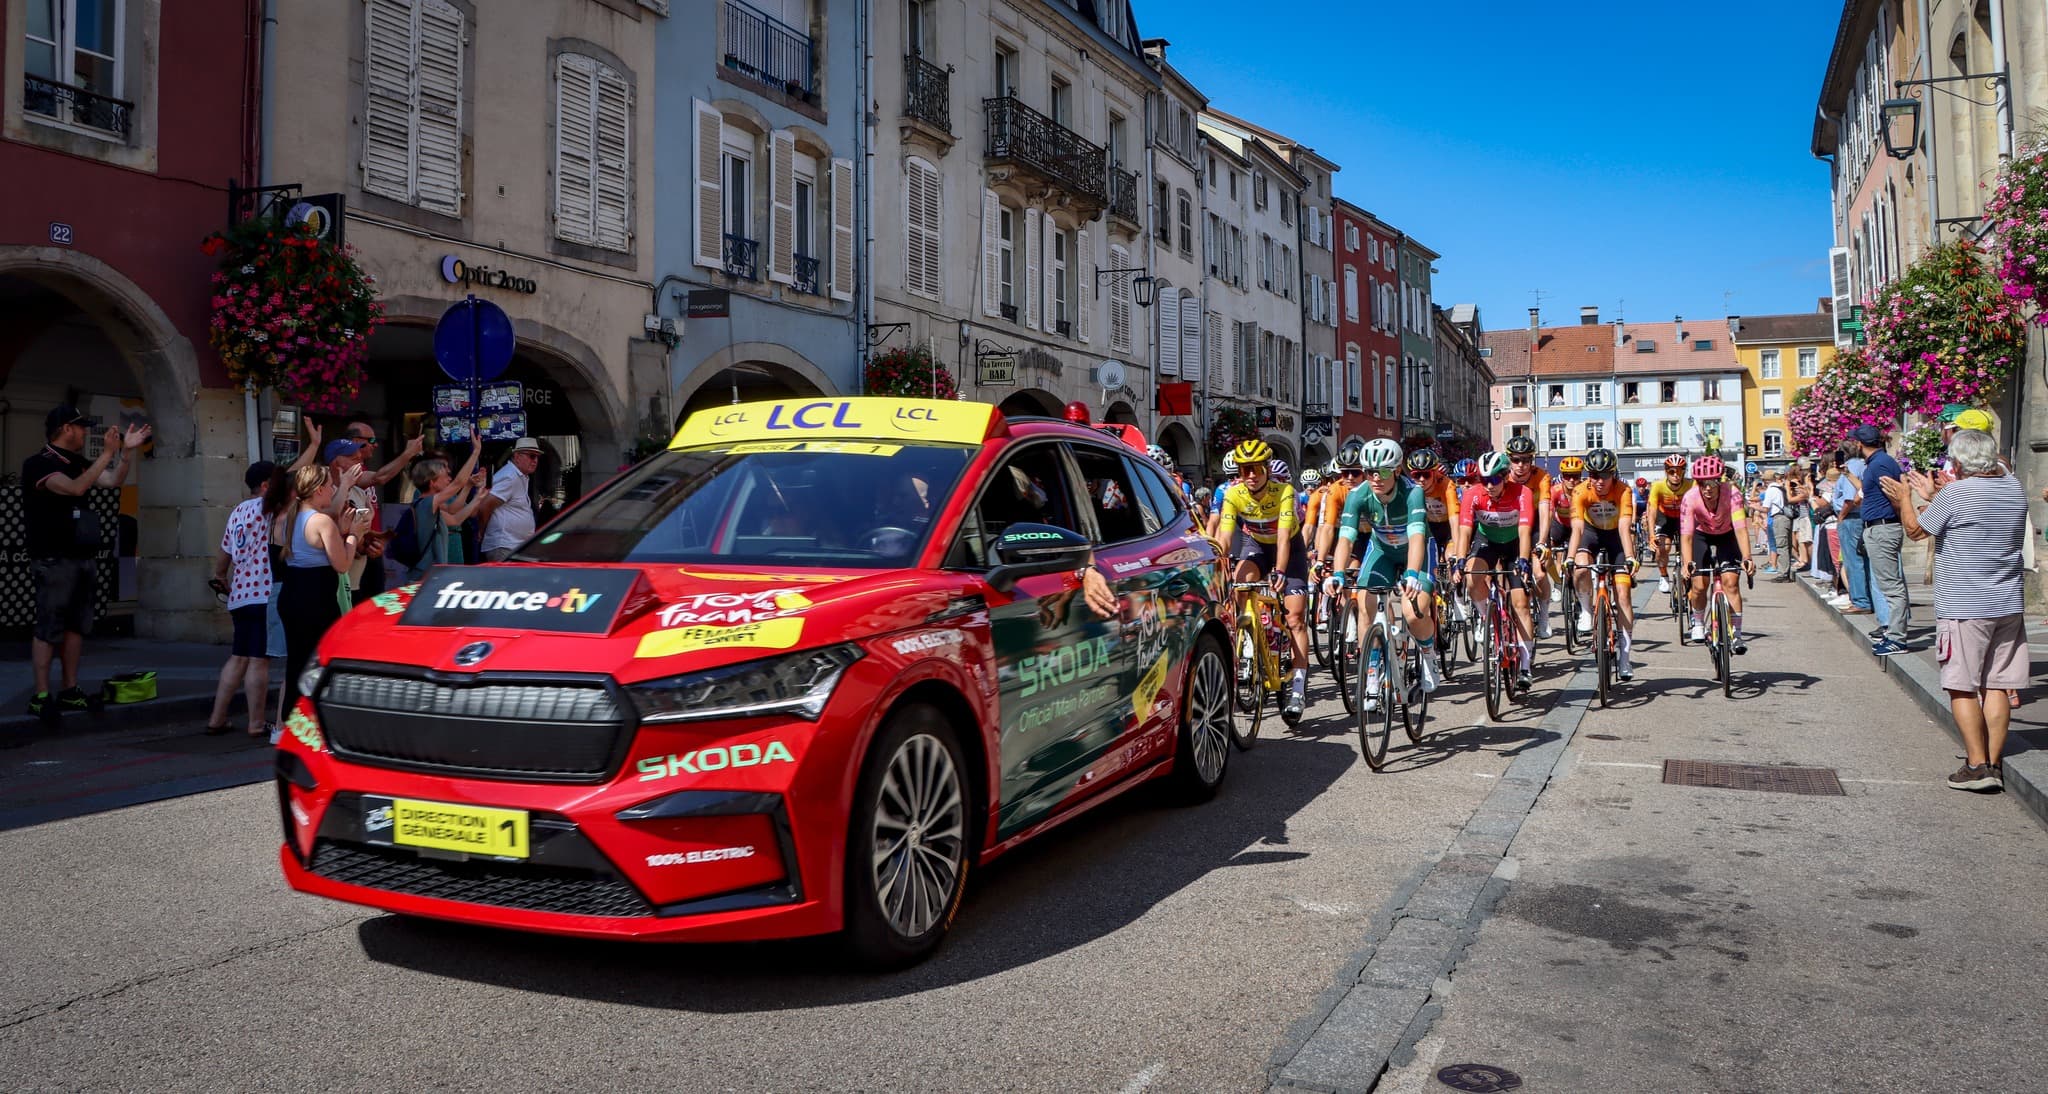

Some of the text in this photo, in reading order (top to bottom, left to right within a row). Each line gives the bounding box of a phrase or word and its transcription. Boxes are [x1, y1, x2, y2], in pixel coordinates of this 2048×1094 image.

[53, 225, 70, 242] 22
[447, 257, 536, 294] Optic2000
[989, 369, 1006, 380] BAR
[524, 388, 552, 405] RGE
[714, 412, 748, 426] LCL
[765, 402, 862, 430] LCL
[895, 407, 939, 422] LCL
[870, 445, 880, 454] 1
[1004, 532, 1063, 542] SKODA
[1019, 637, 1111, 698] SKODA
[636, 741, 795, 782] SKODA
[401, 808, 486, 829] DIRECTION
[498, 819, 516, 848] 1
[645, 845, 755, 867] 100% ELECTRIC
